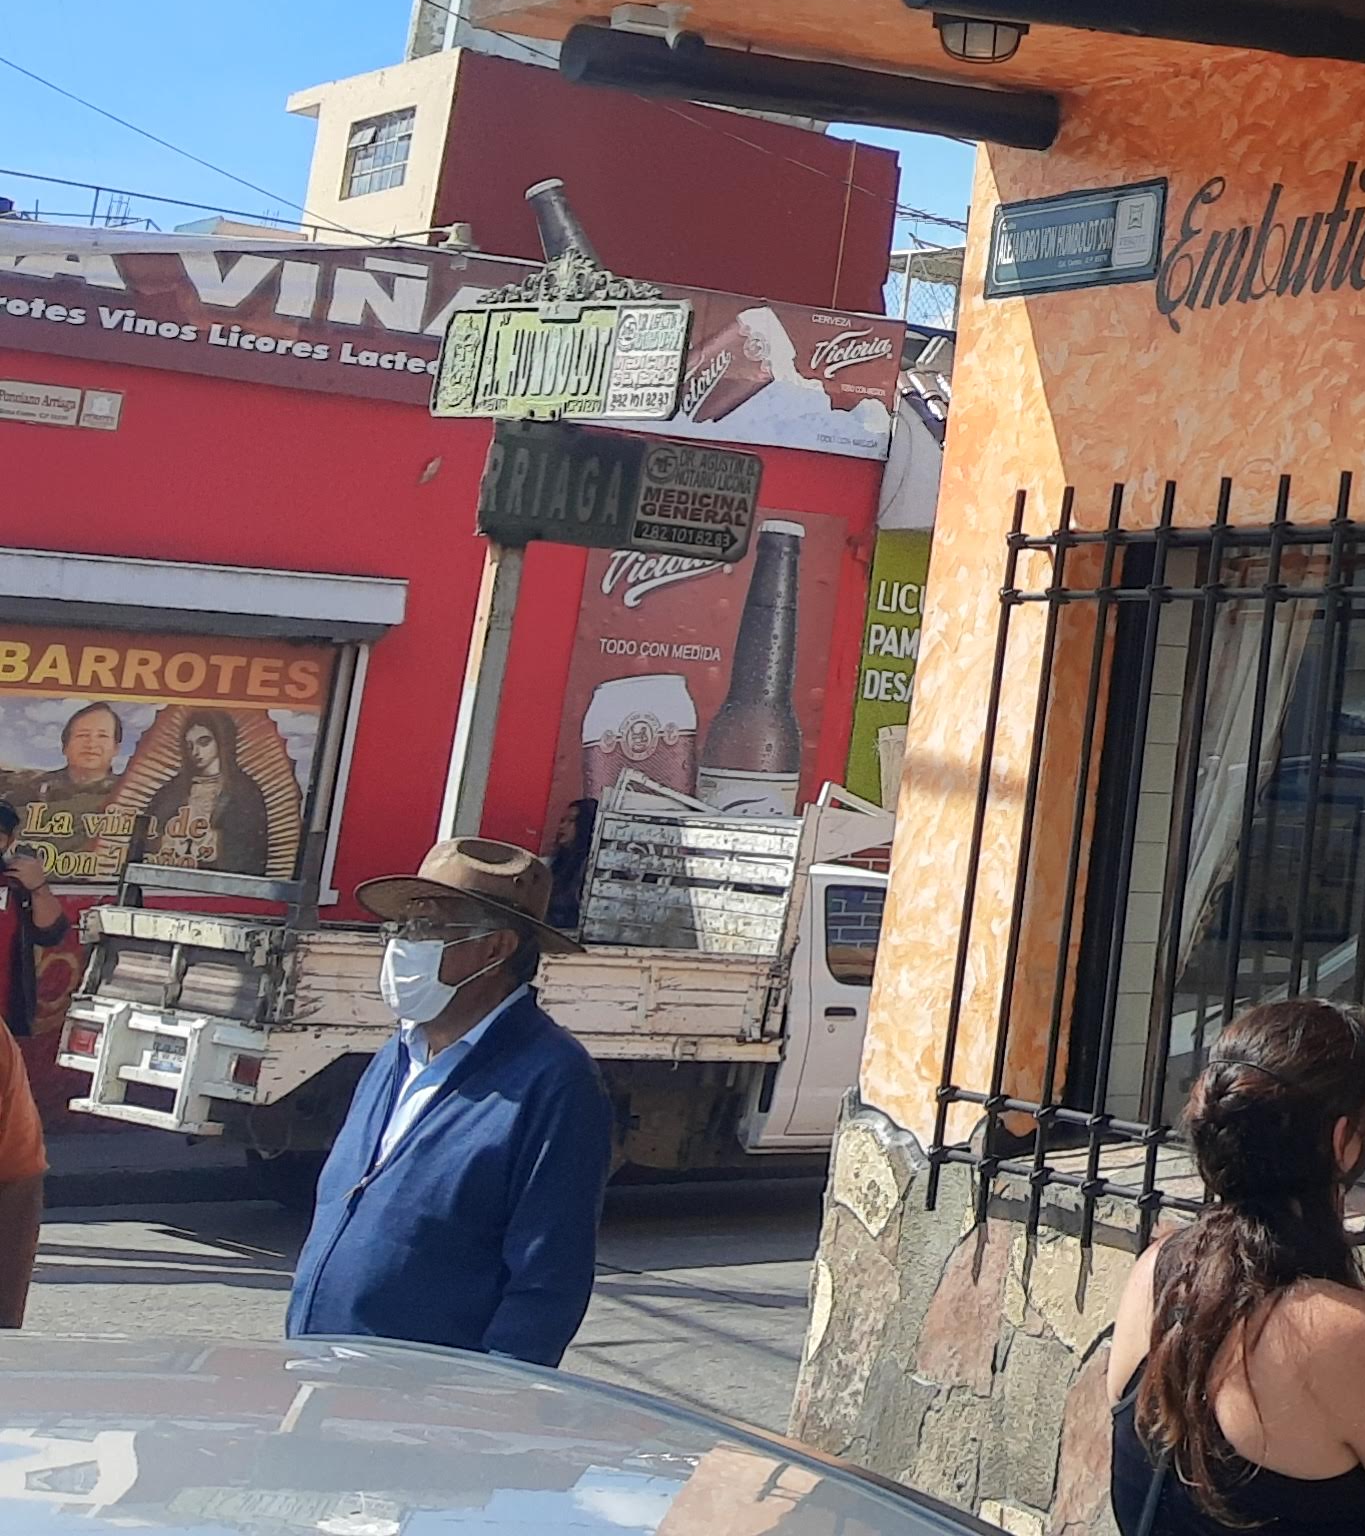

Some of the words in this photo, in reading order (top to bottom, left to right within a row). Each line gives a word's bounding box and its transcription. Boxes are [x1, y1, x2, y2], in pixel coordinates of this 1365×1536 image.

[98, 306, 198, 342] Vinos
[208, 323, 330, 361] Licores
[812, 314, 851, 327] CERVEZA
[810, 327, 893, 379] Victoria
[641, 502, 747, 527] GENERAL
[643, 486, 749, 514] MEDICINA
[600, 638, 638, 655] TODO
[640, 642, 669, 657] CON
[671, 645, 721, 661] MEDIDA
[0, 641, 320, 700] BARROTES
[22, 802, 73, 837] La
[167, 806, 209, 839] de
